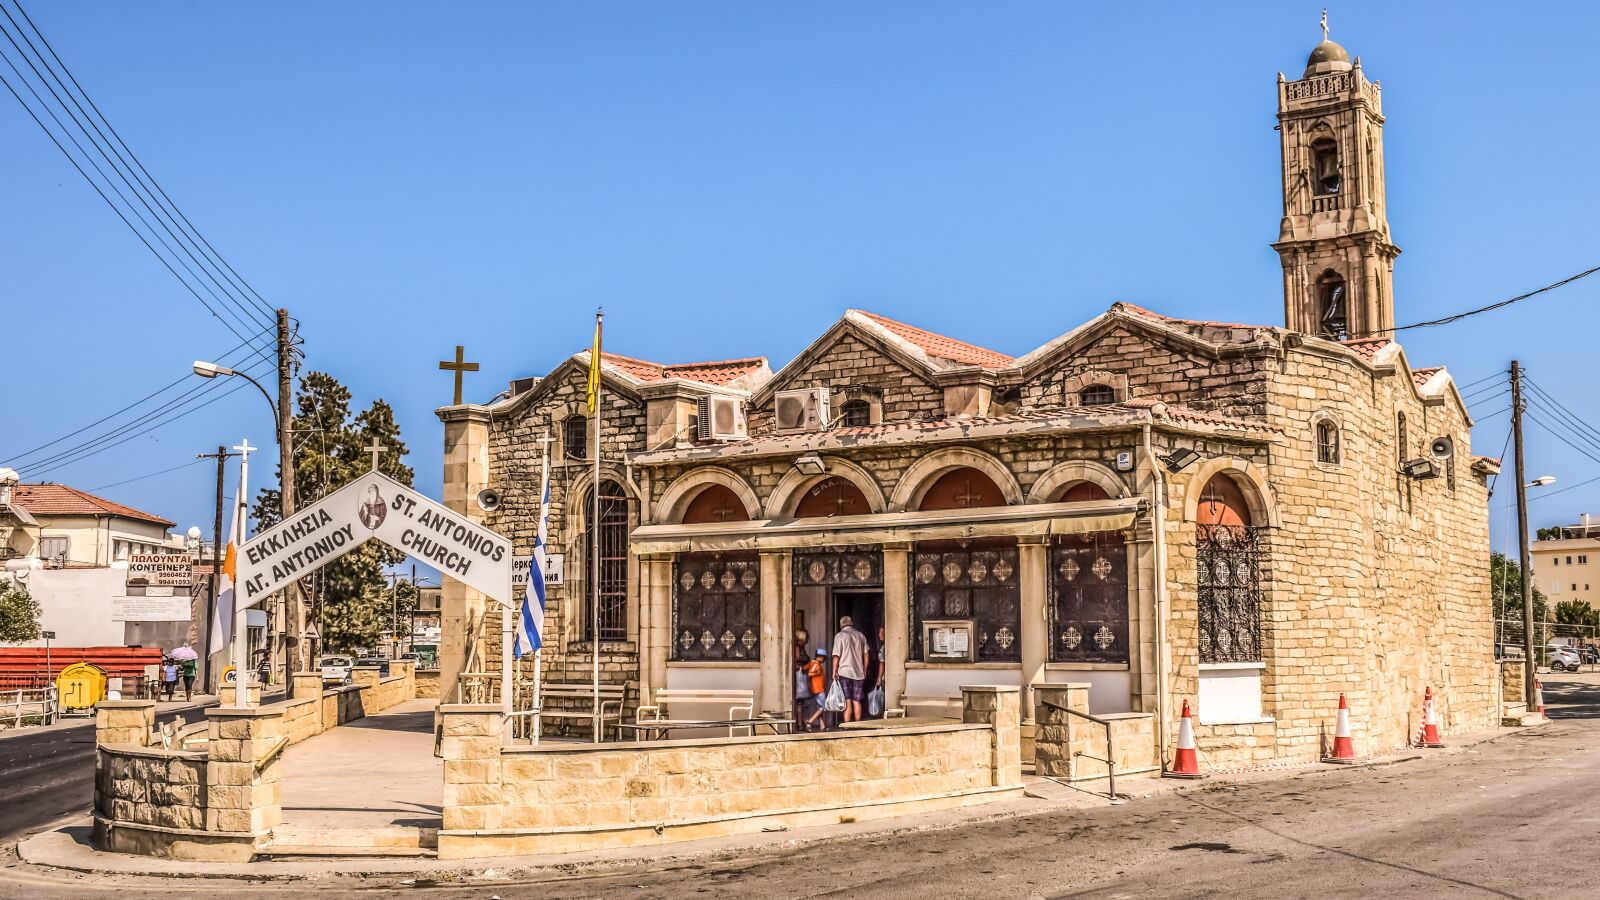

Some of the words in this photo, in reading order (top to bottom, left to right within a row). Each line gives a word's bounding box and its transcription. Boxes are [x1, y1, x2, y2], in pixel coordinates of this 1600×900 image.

[245, 508, 333, 566] ΕΚΚΛΗΣΙΑ
[391, 493, 417, 518] ST.
[417, 508, 505, 562] ANTONIOS
[400, 529, 472, 576] CHURCH
[131, 555, 191, 563] ΠΩΛΟΥΝΤΑΙ
[245, 573, 270, 598] ΑΓ.
[272, 523, 354, 583] ΑΝΤΩΝΙΟΥ
